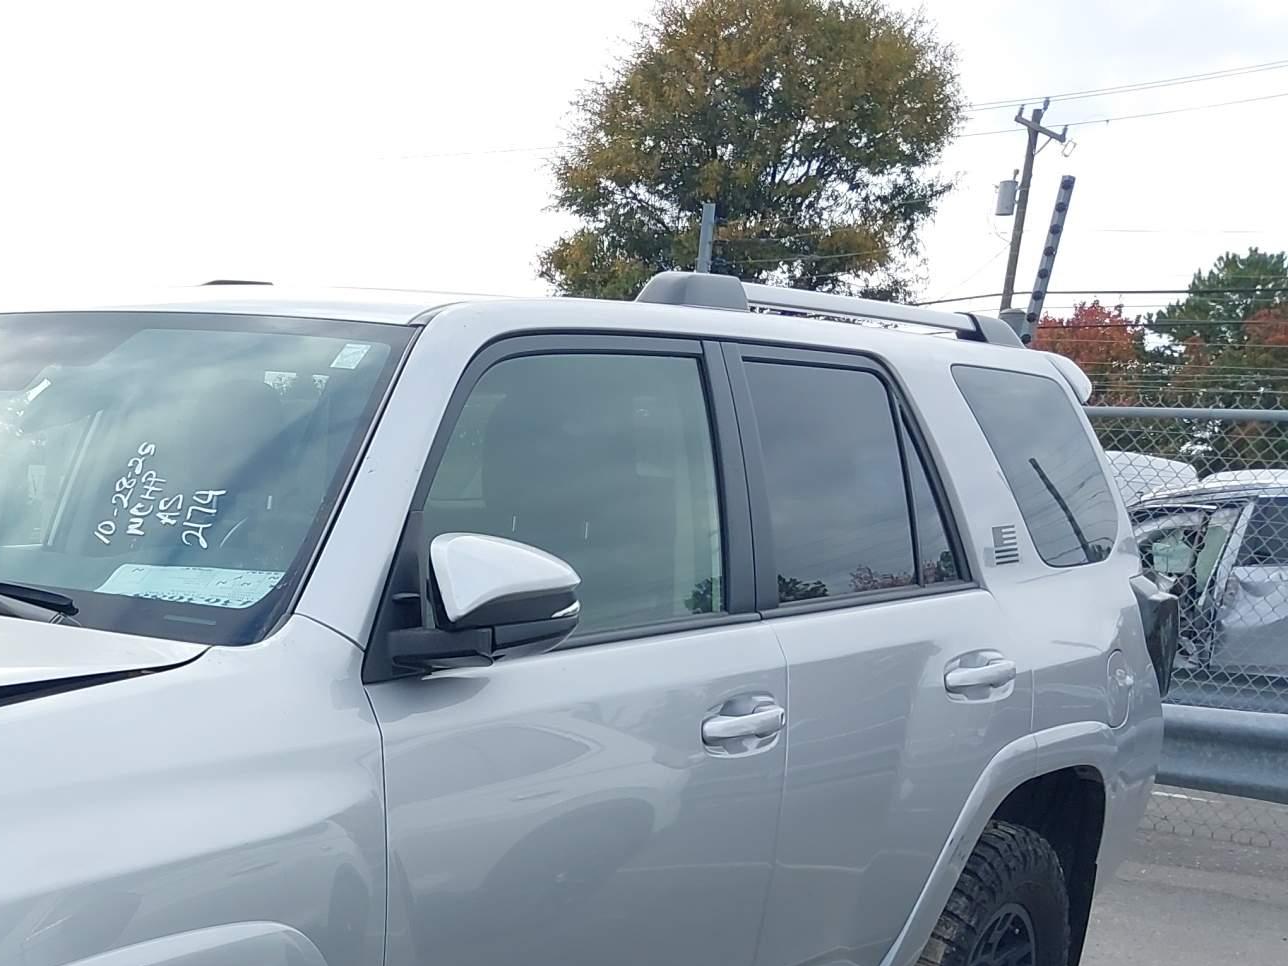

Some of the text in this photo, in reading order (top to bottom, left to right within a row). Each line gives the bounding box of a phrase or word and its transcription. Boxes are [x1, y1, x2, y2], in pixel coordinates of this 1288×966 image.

[94, 441, 156, 545] 10-28-25
[155, 494, 184, 525] AS
[181, 489, 227, 549] 2174
